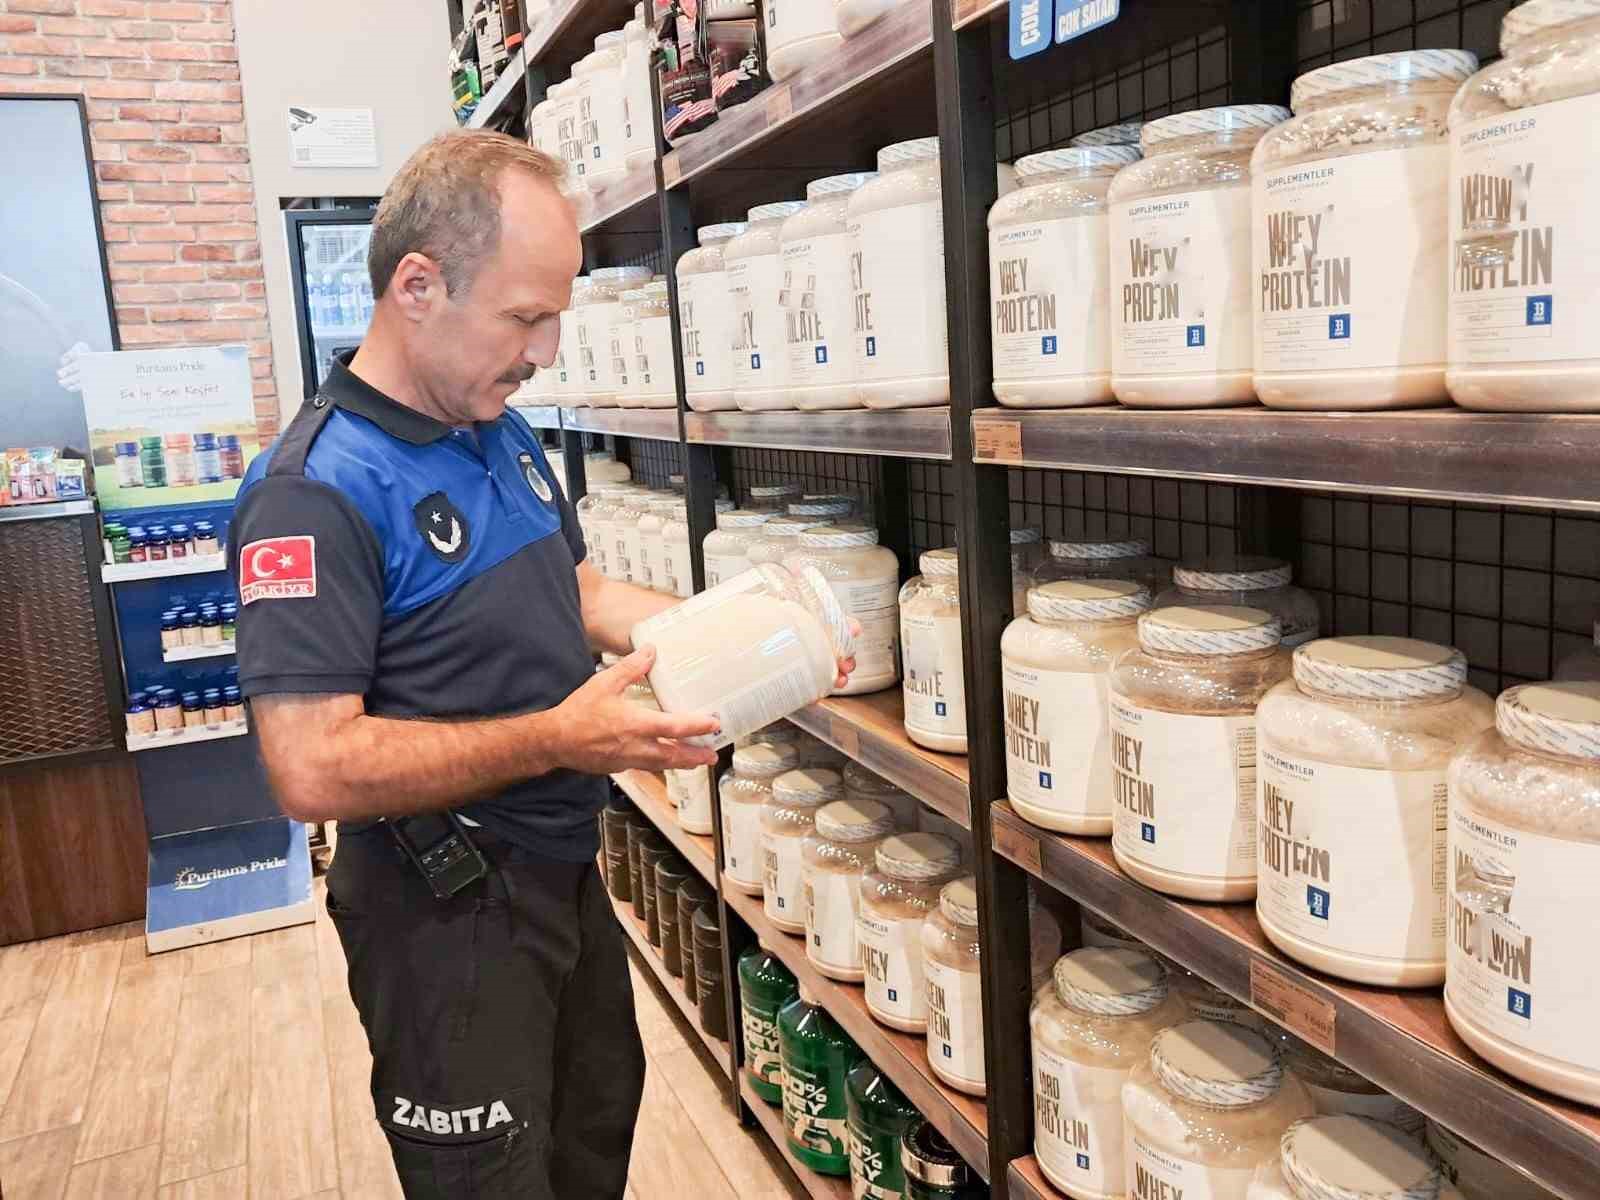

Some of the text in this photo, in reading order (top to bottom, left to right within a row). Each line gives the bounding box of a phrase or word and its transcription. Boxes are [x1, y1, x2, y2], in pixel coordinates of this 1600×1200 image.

[1265, 167, 1335, 189] SUPPLEMENTLER
[996, 293, 1056, 334] PROTEIN
[250, 857, 287, 873] Pride
[392, 1096, 514, 1135] ZABITA
